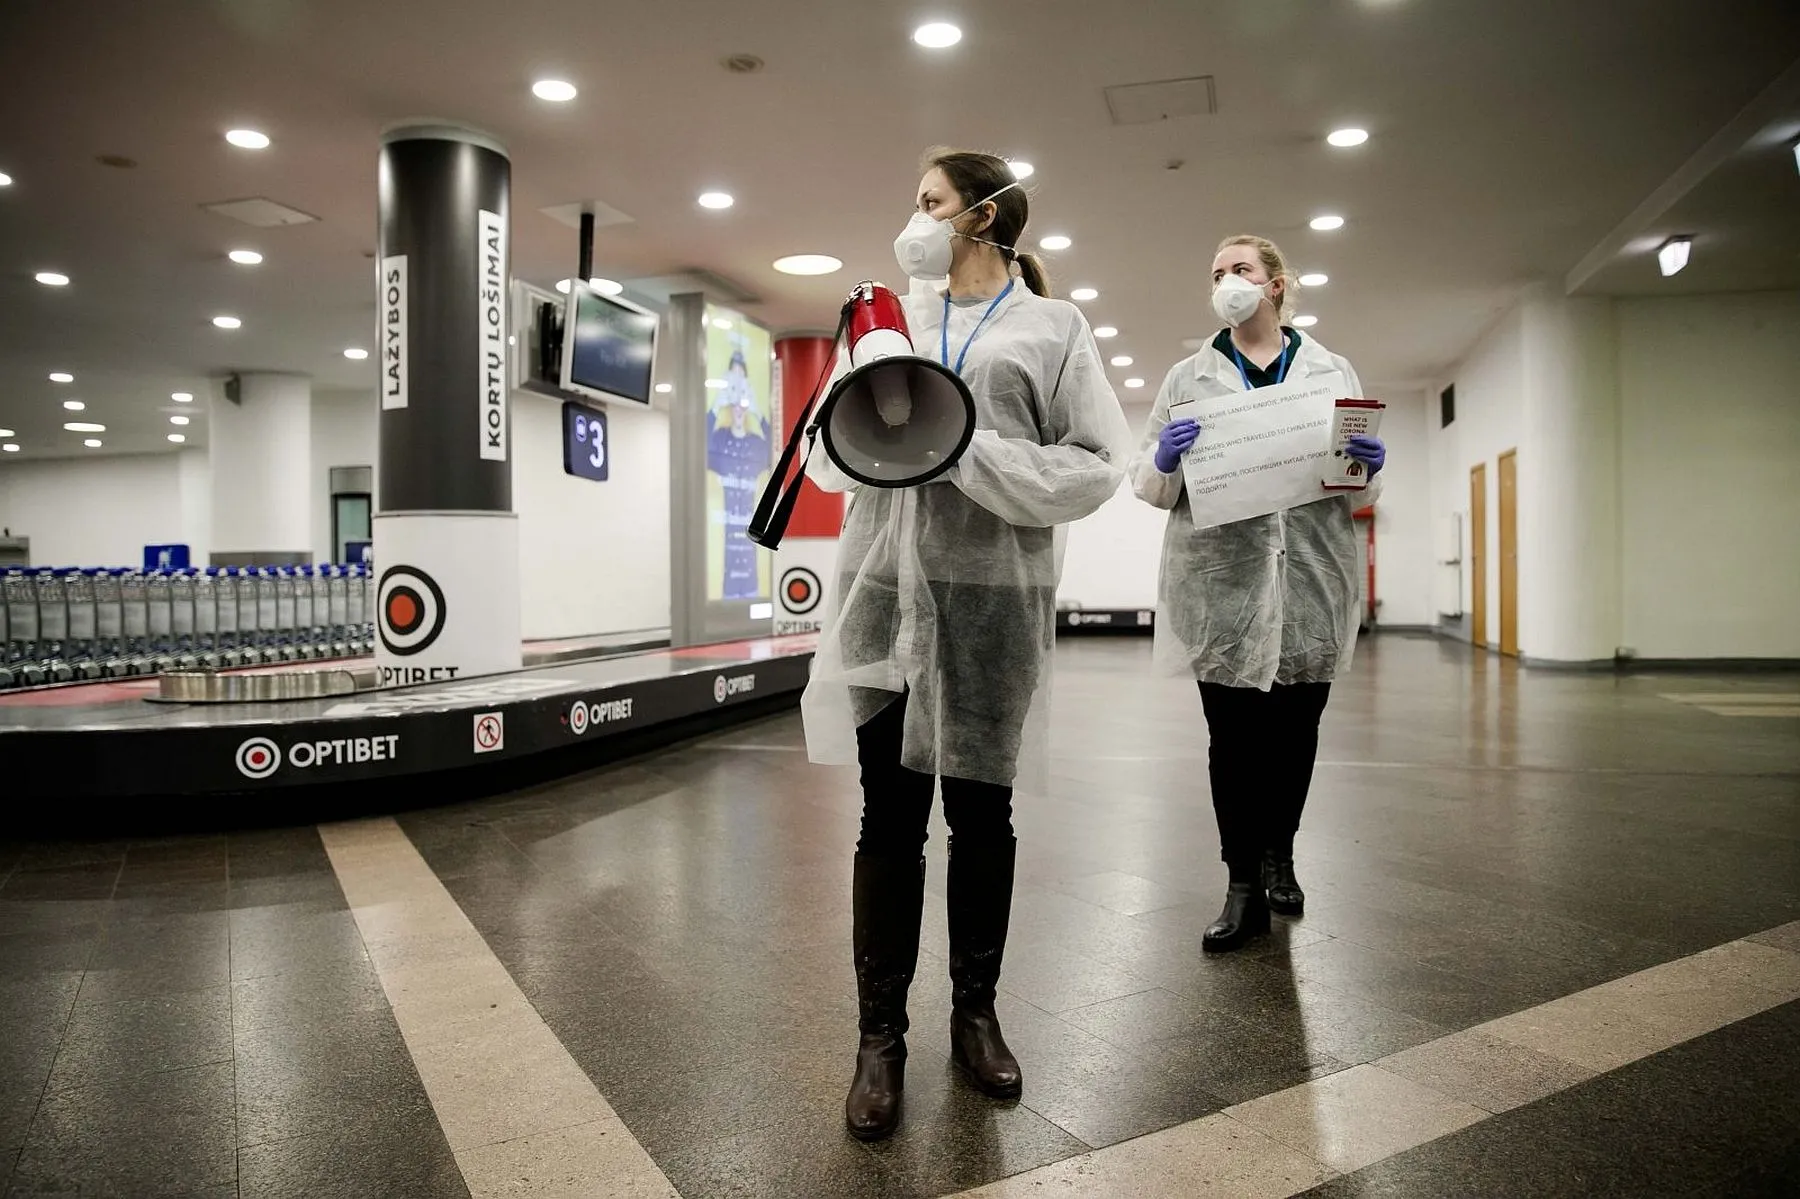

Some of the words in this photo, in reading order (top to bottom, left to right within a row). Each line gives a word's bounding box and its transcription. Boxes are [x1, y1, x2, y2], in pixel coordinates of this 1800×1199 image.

[482, 225, 501, 341] LOŠIMAI
[487, 352, 504, 448] KORTŲ
[588, 420, 604, 468] 3
[1225, 438, 1242, 447] WHO
[1287, 423, 1305, 433] CHINA
[1306, 418, 1328, 428] PLEASE
[1189, 456, 1207, 466] COME
[1196, 483, 1227, 495] ПОДОЙТИ
[589, 697, 634, 725] OPTIBET
[288, 734, 399, 768] OPTIBET
